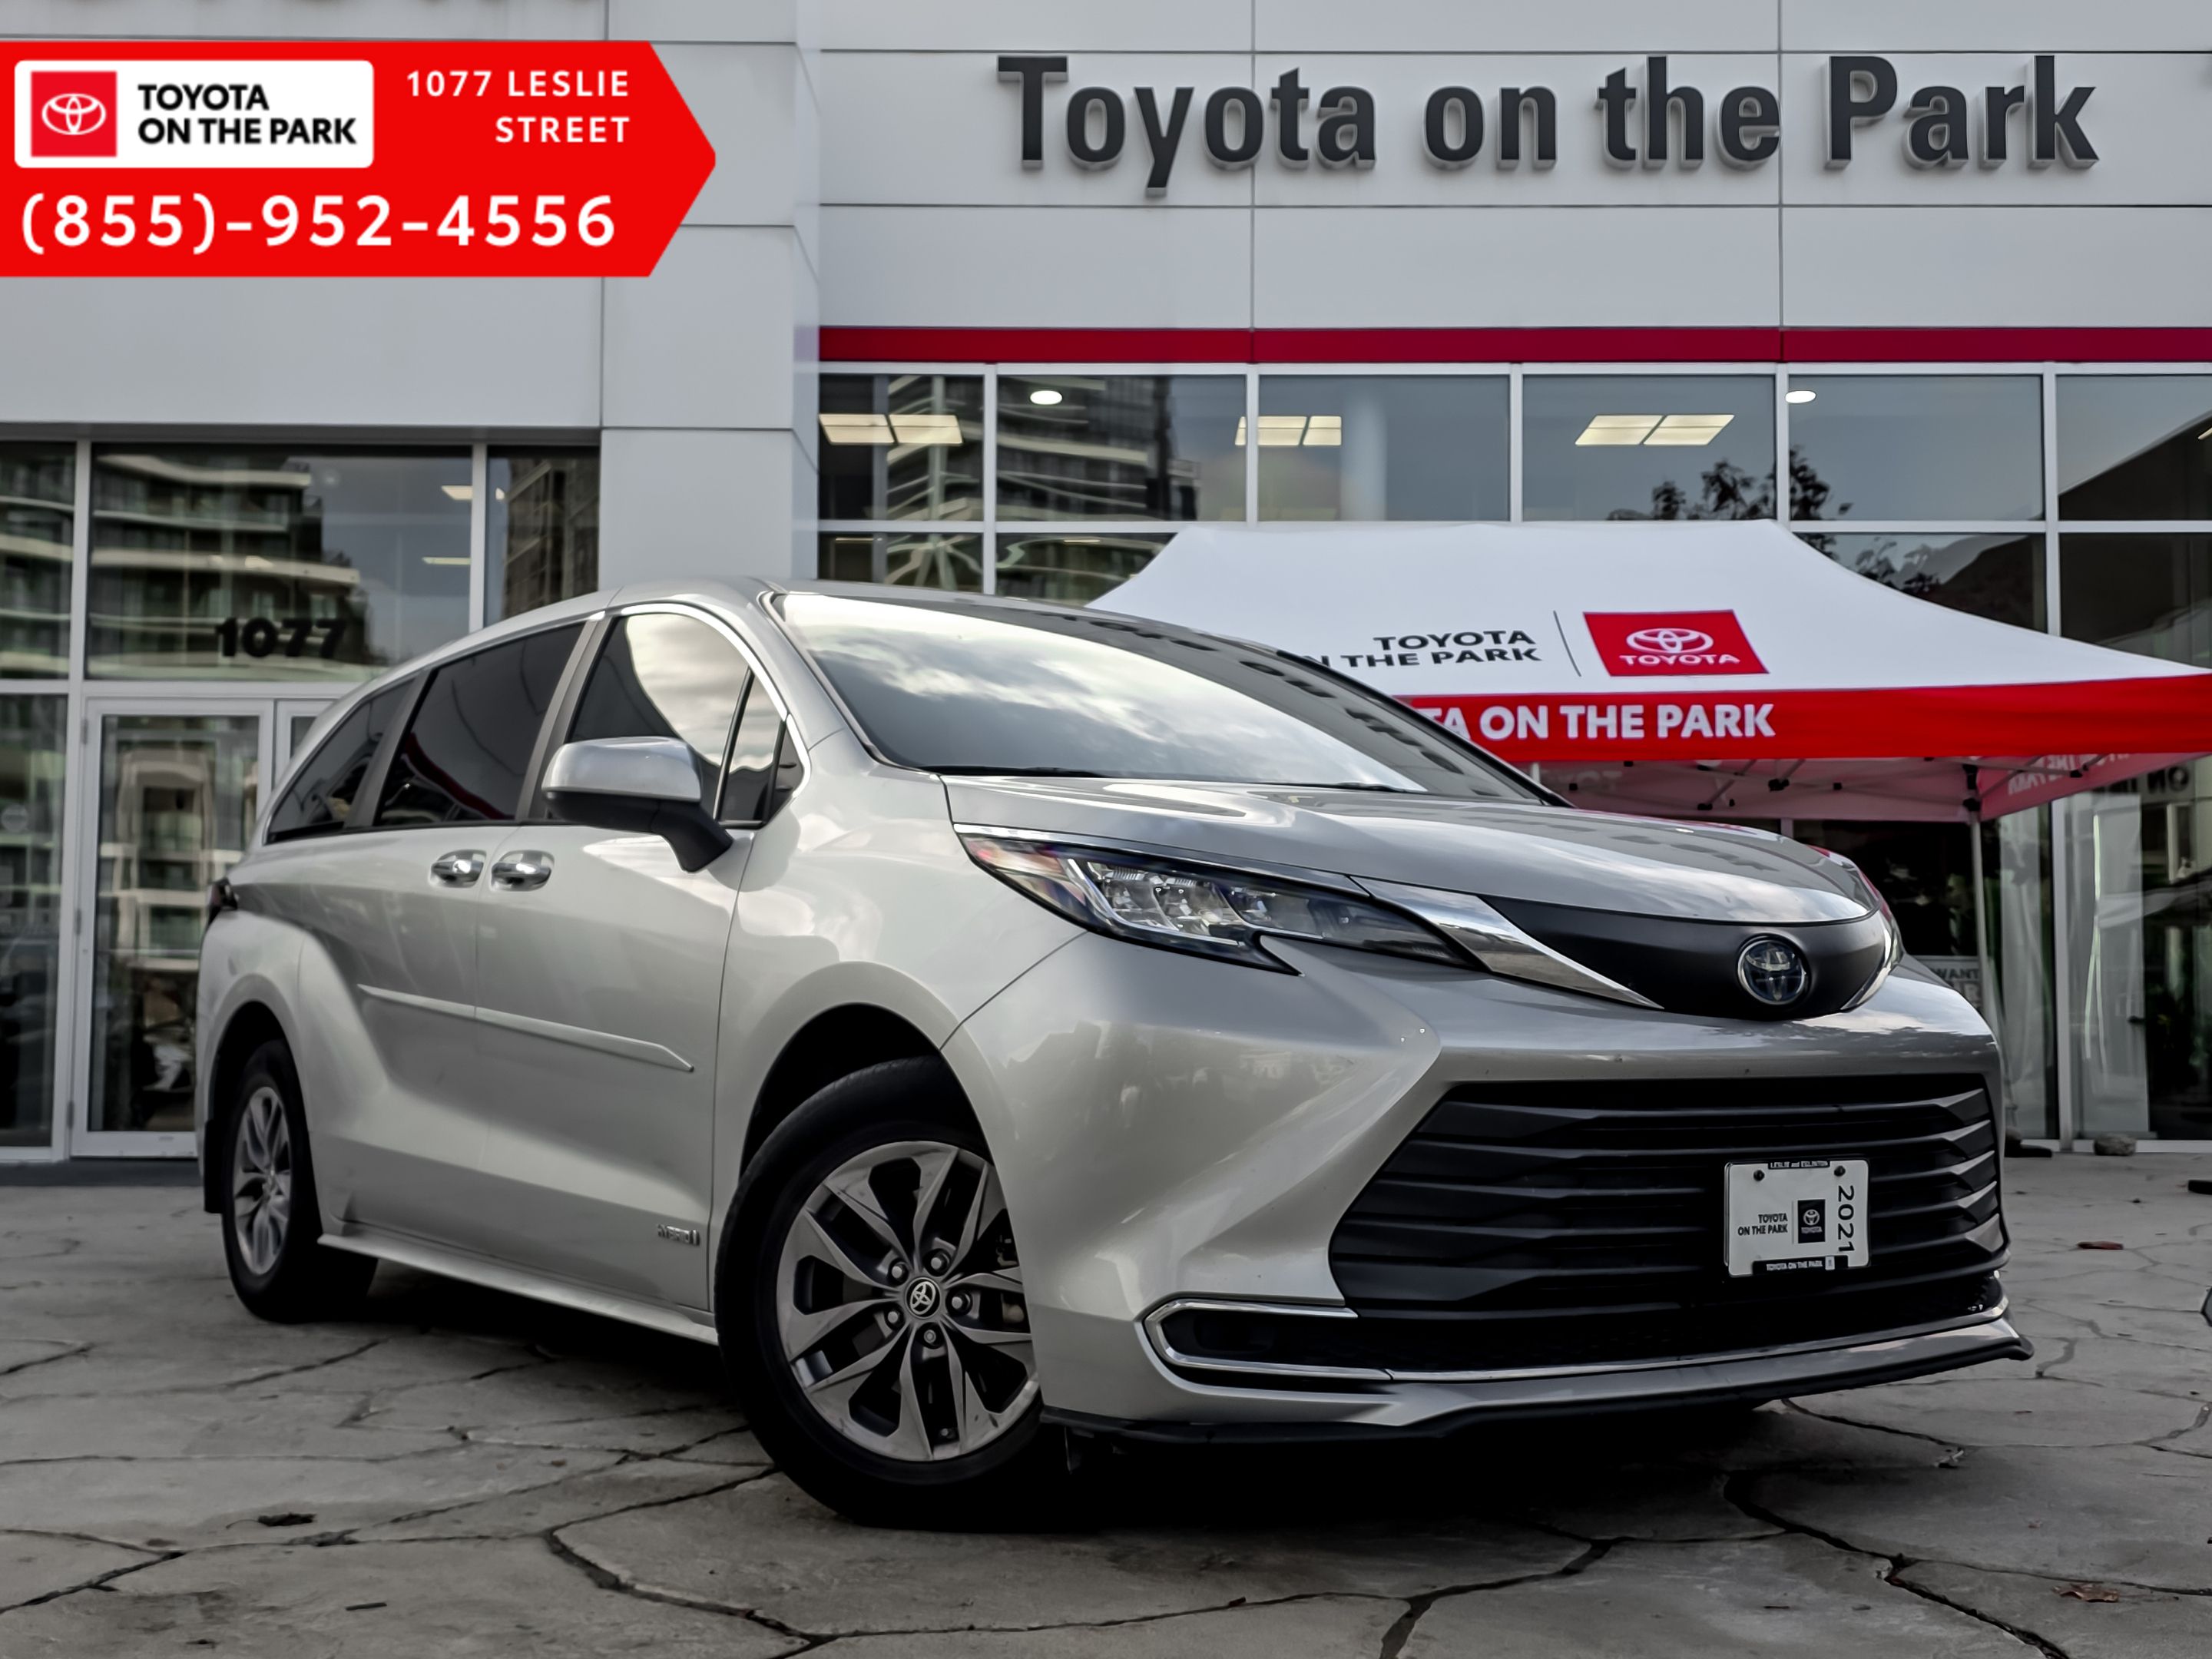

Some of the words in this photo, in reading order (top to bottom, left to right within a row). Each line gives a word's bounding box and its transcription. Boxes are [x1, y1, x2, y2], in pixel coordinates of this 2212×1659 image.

[997, 55, 1376, 195] Toyota
[1424, 85, 1558, 170] on
[1598, 55, 1780, 170] the
[1825, 55, 2099, 170] Park
[216, 617, 346, 658] 1077
[1373, 630, 1535, 651] TOYOTA
[1340, 654, 1420, 667] THE
[1431, 648, 1542, 664] PARK
[1618, 654, 1740, 666] TOYOTA
[1479, 705, 1548, 740] ON
[1559, 704, 1644, 739] THE
[1657, 704, 1777, 738] PARK
[1758, 1213, 1788, 1224] TOYOTA
[1838, 1185, 1855, 1252] 2021
[1737, 1226, 1750, 1236] ON
[1752, 1225, 1766, 1235] THE
[1768, 1224, 1788, 1234] PARK
